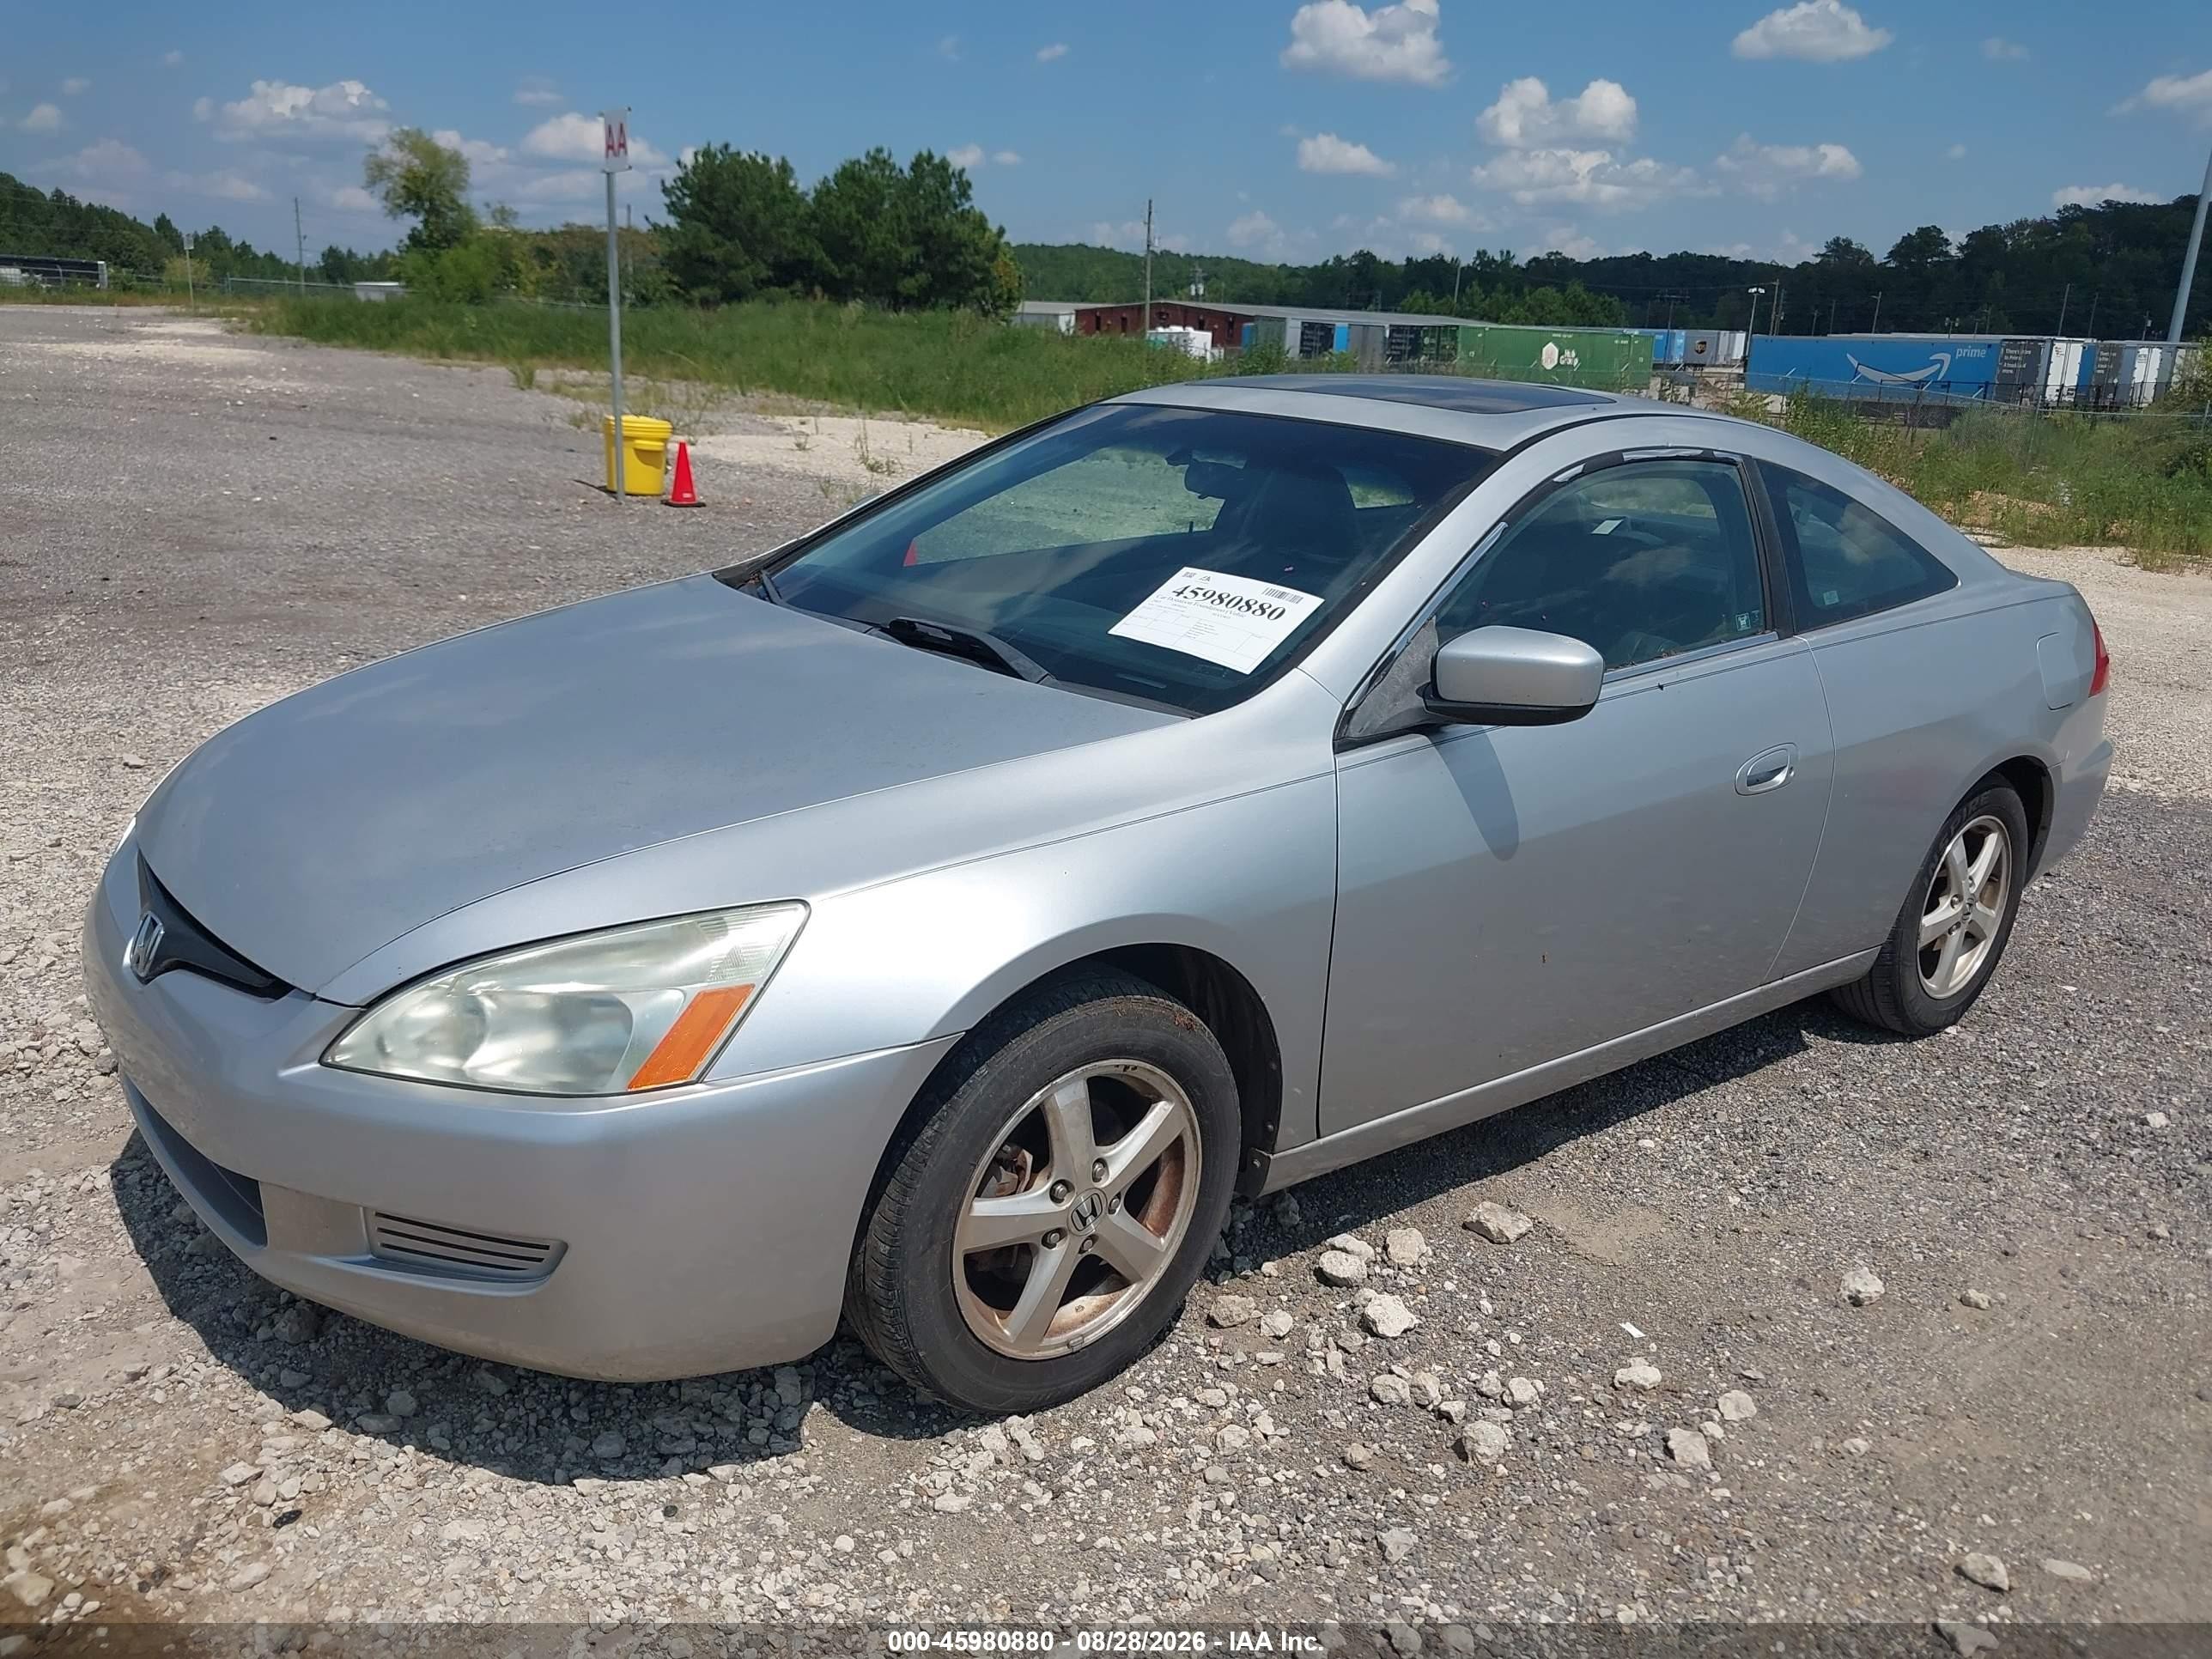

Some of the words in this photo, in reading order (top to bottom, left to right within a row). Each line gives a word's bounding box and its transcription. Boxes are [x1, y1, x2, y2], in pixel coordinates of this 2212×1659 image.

[605, 123, 628, 158] AA
[1955, 345, 1986, 360] prime
[1171, 585, 1286, 621] 45980880
